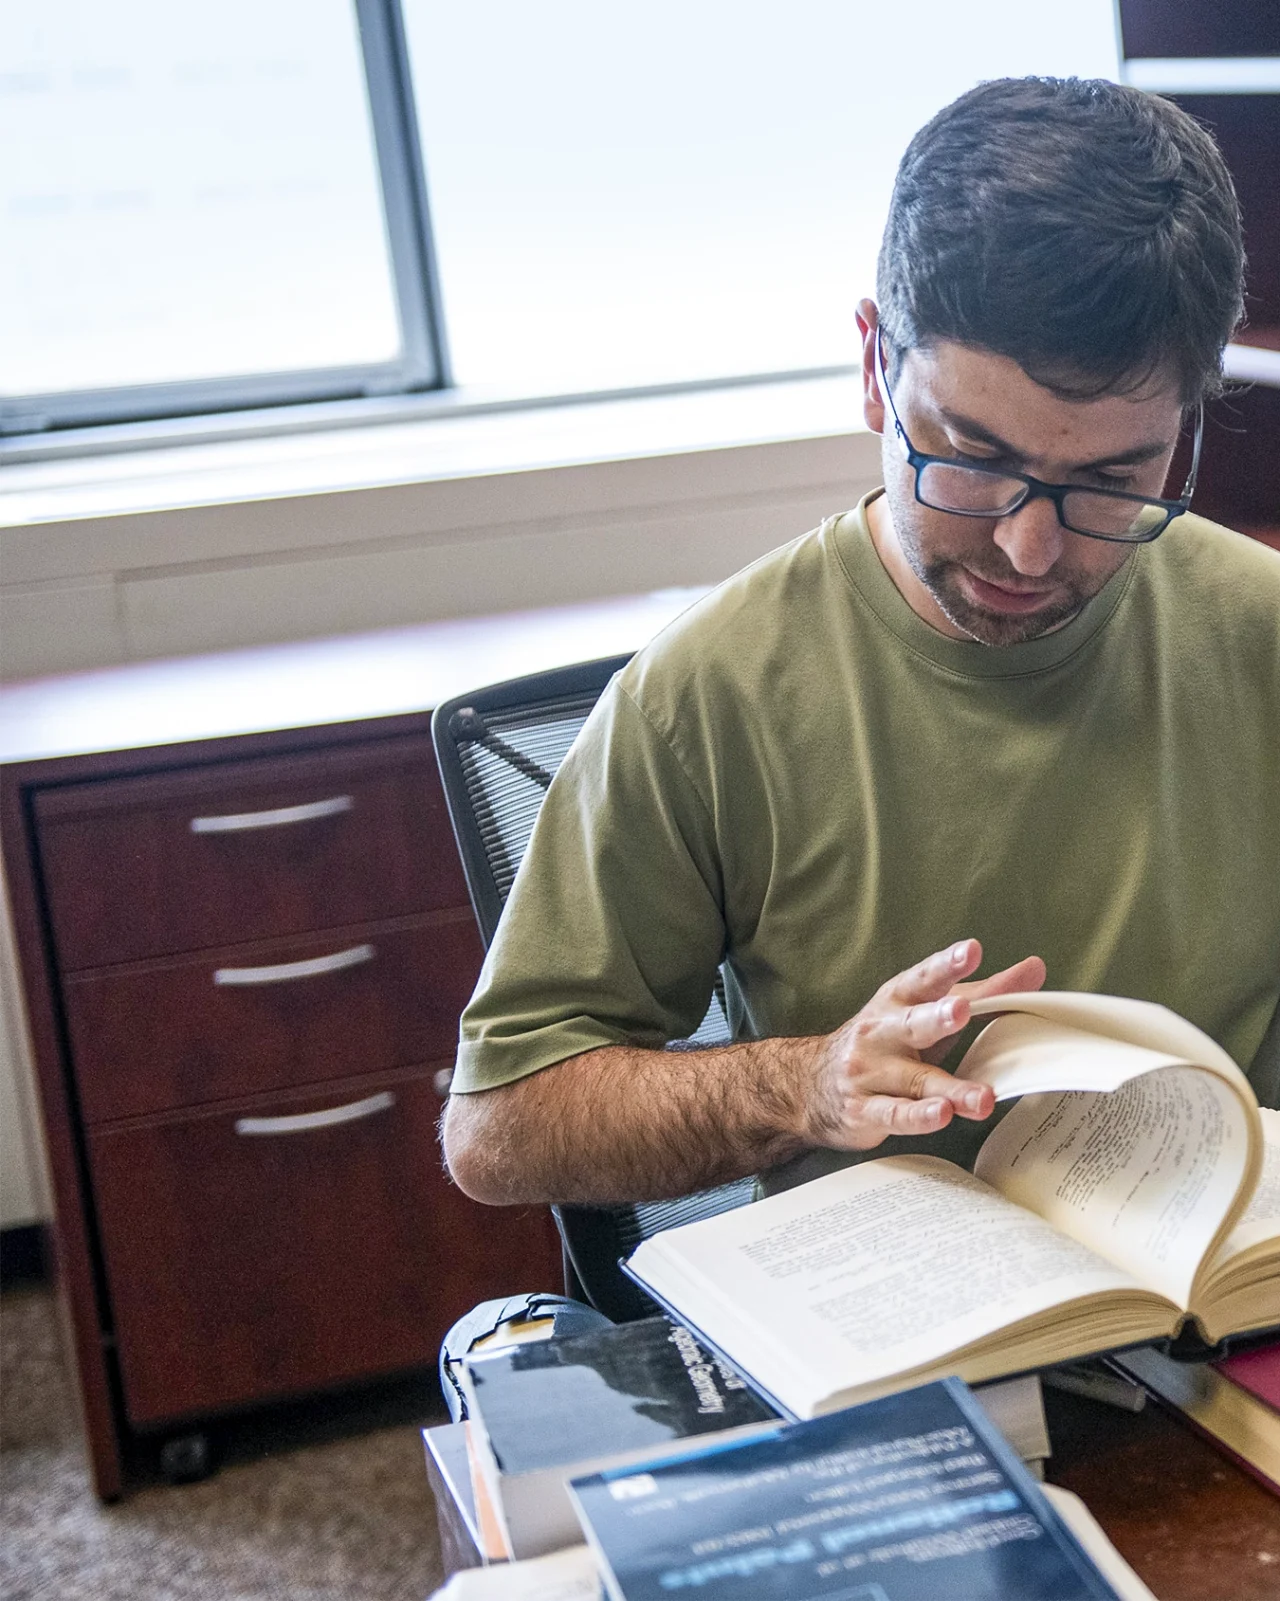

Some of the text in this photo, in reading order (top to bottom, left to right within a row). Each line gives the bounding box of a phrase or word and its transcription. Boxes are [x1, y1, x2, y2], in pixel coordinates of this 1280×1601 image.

[668, 1327, 704, 1366] Algebraic
[687, 1363, 726, 1414] Geometry
[820, 1488, 1020, 1553] Rational
[659, 1538, 816, 1591] Points
